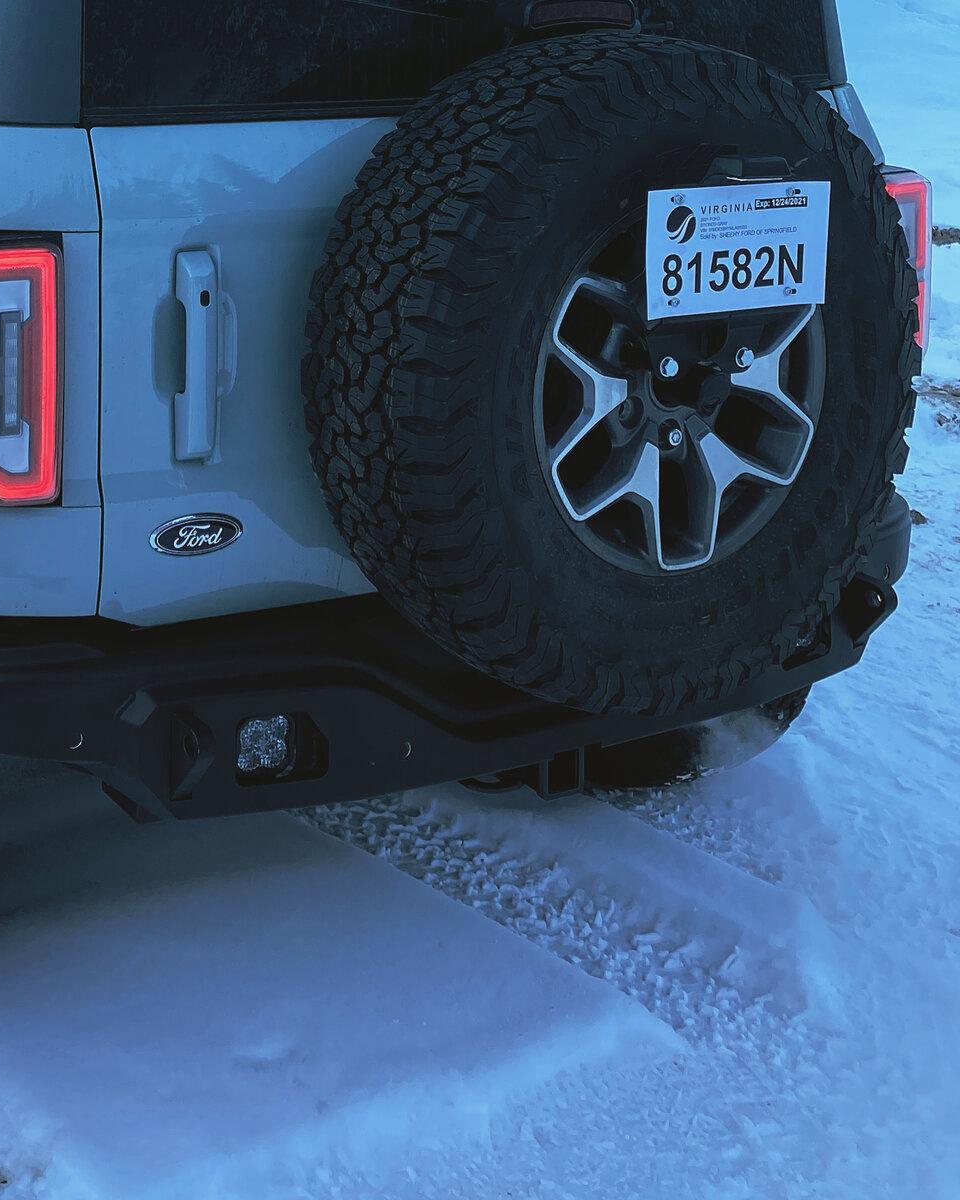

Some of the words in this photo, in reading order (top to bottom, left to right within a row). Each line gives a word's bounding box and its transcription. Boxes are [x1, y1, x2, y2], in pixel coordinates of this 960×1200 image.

[701, 202, 753, 215] VIRGINIA
[755, 199, 771, 209] Exp:
[771, 197, 807, 207] 12/24/2021
[740, 229, 755, 237] FORD
[662, 243, 805, 297] 81582N
[173, 524, 223, 549] Ford
